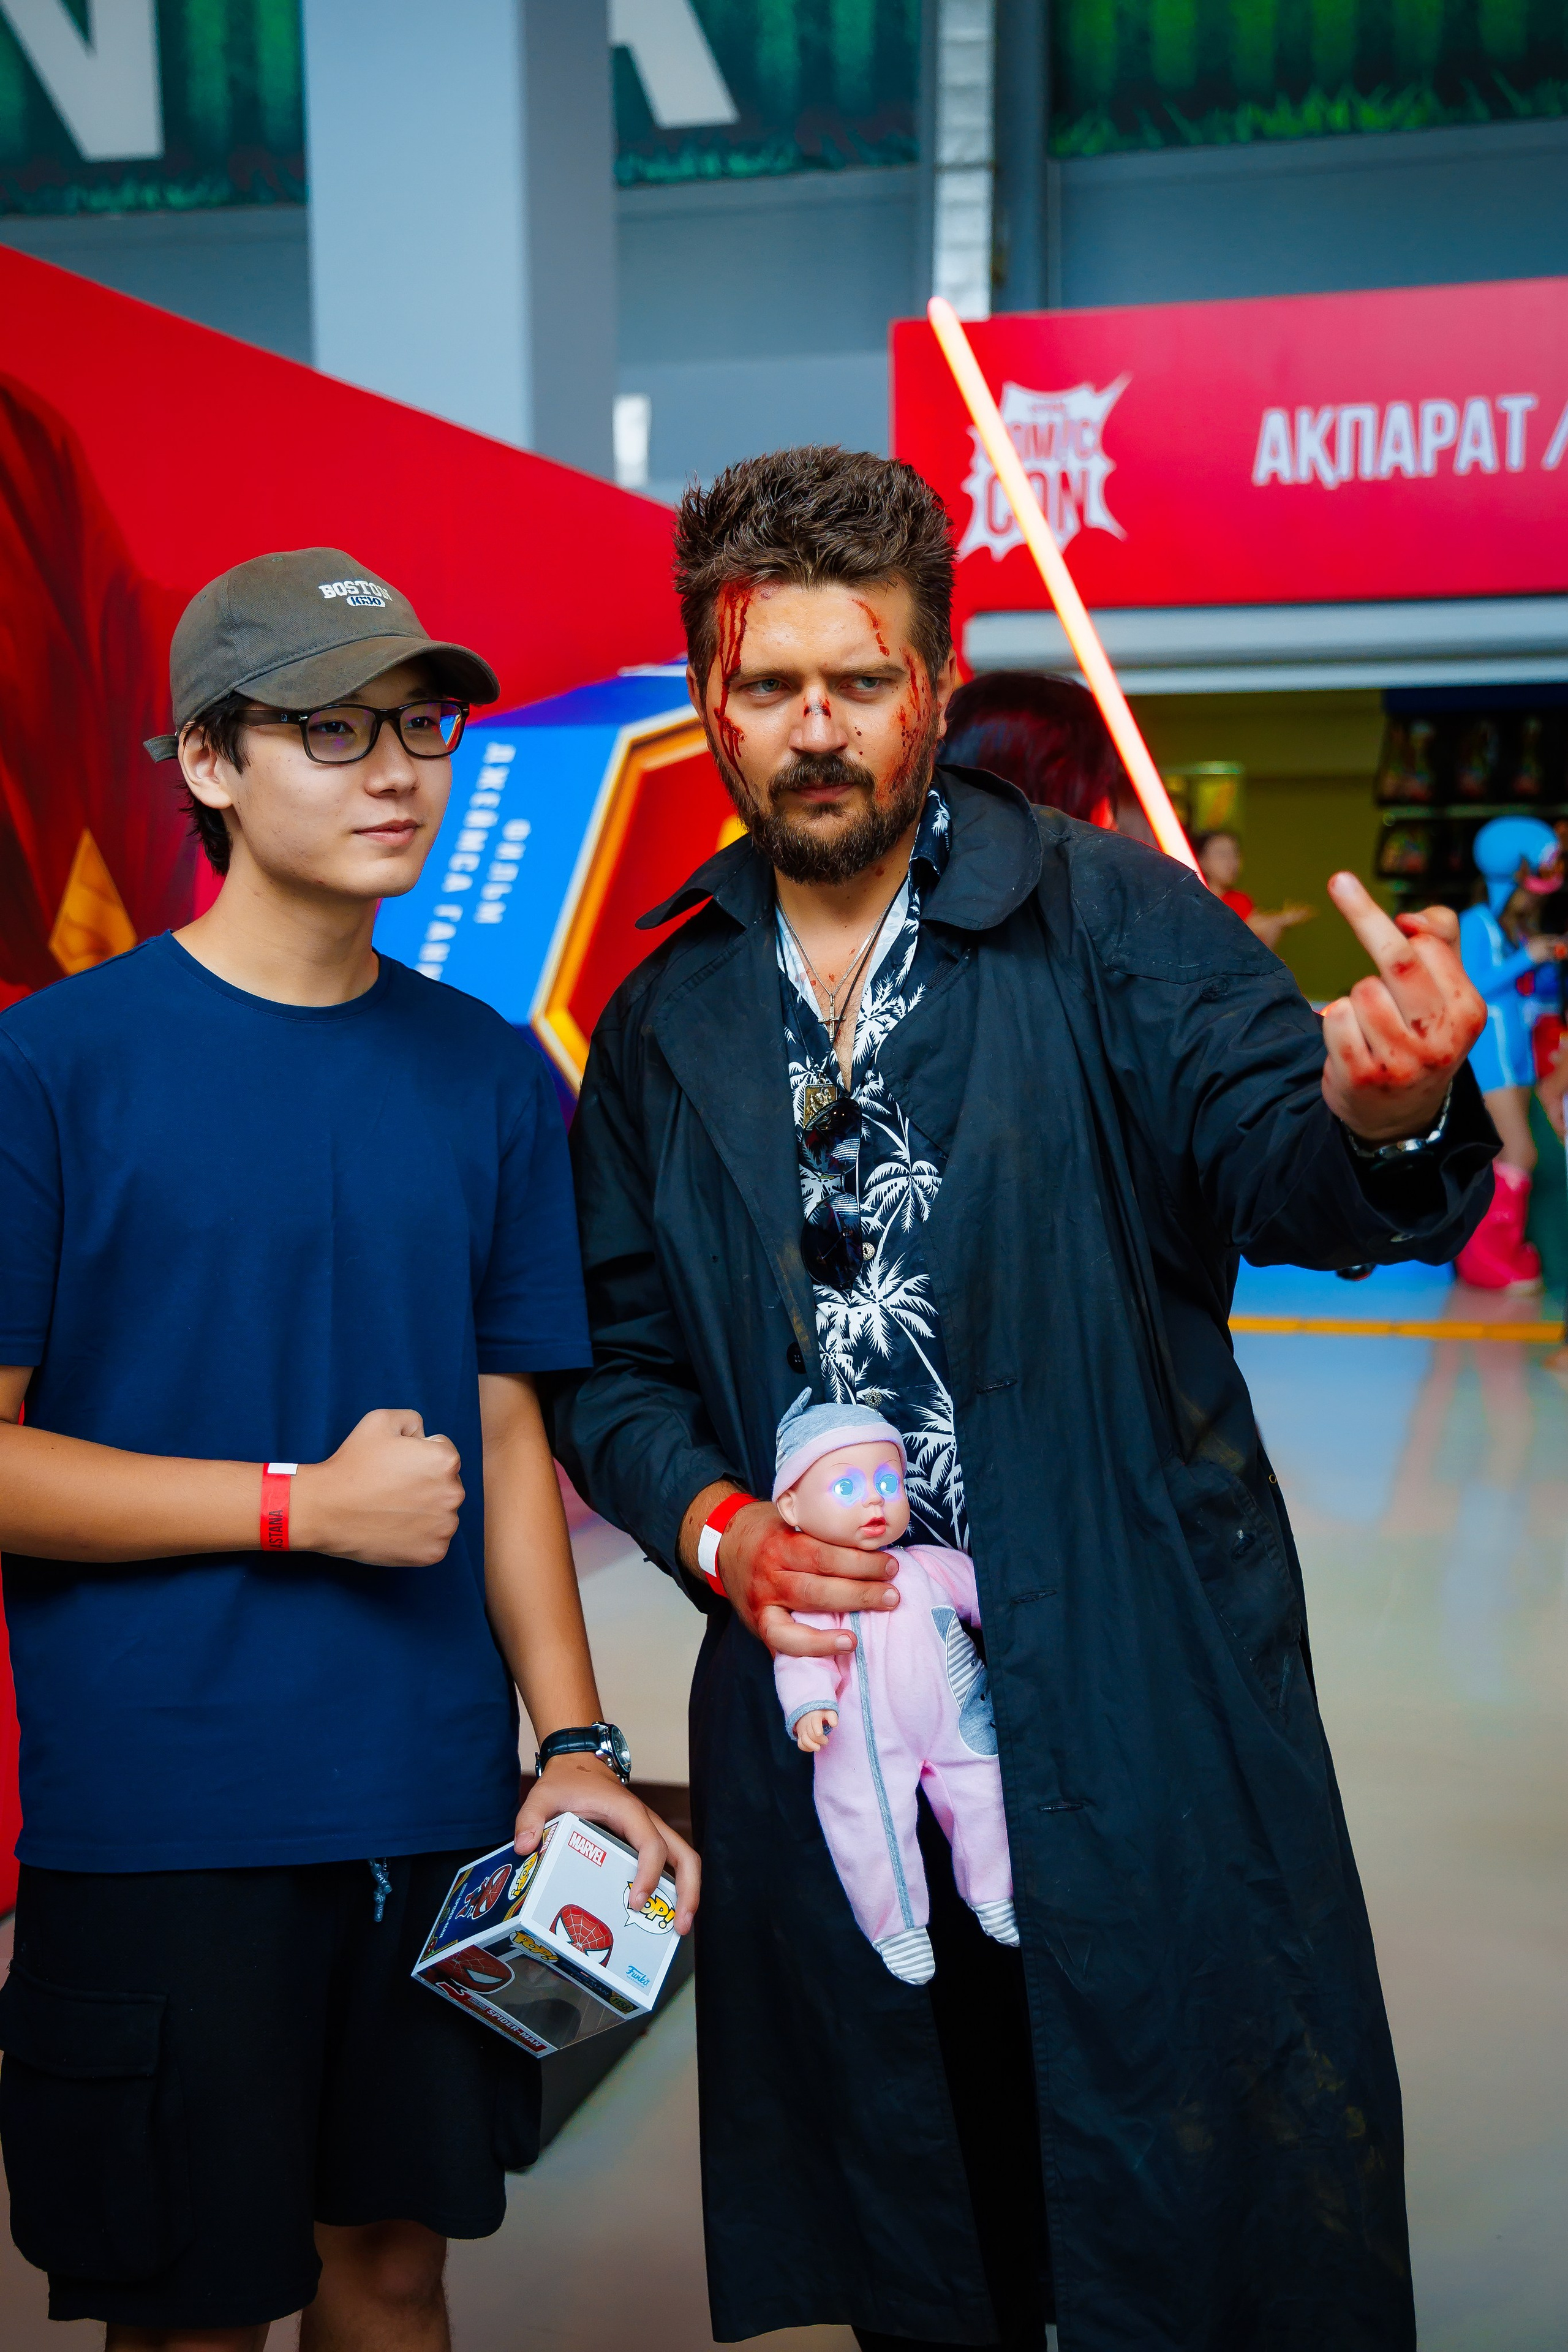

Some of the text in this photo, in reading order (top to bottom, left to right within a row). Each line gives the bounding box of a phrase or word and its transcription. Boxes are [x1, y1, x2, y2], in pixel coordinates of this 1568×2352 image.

[1253, 393, 1538, 489] АҚПАРАТ
[318, 581, 393, 601] BOSTON
[473, 818, 532, 924] ФИЛЬМ
[568, 1831, 607, 1866] MARVEL
[511, 1852, 538, 1897] POP!
[627, 1881, 676, 1929] OP!
[513, 1930, 559, 1960] POP!
[625, 1965, 651, 1986] Funko
[612, 1997, 631, 2010] 1158
[487, 2009, 541, 2047] SPIDER-MAN
